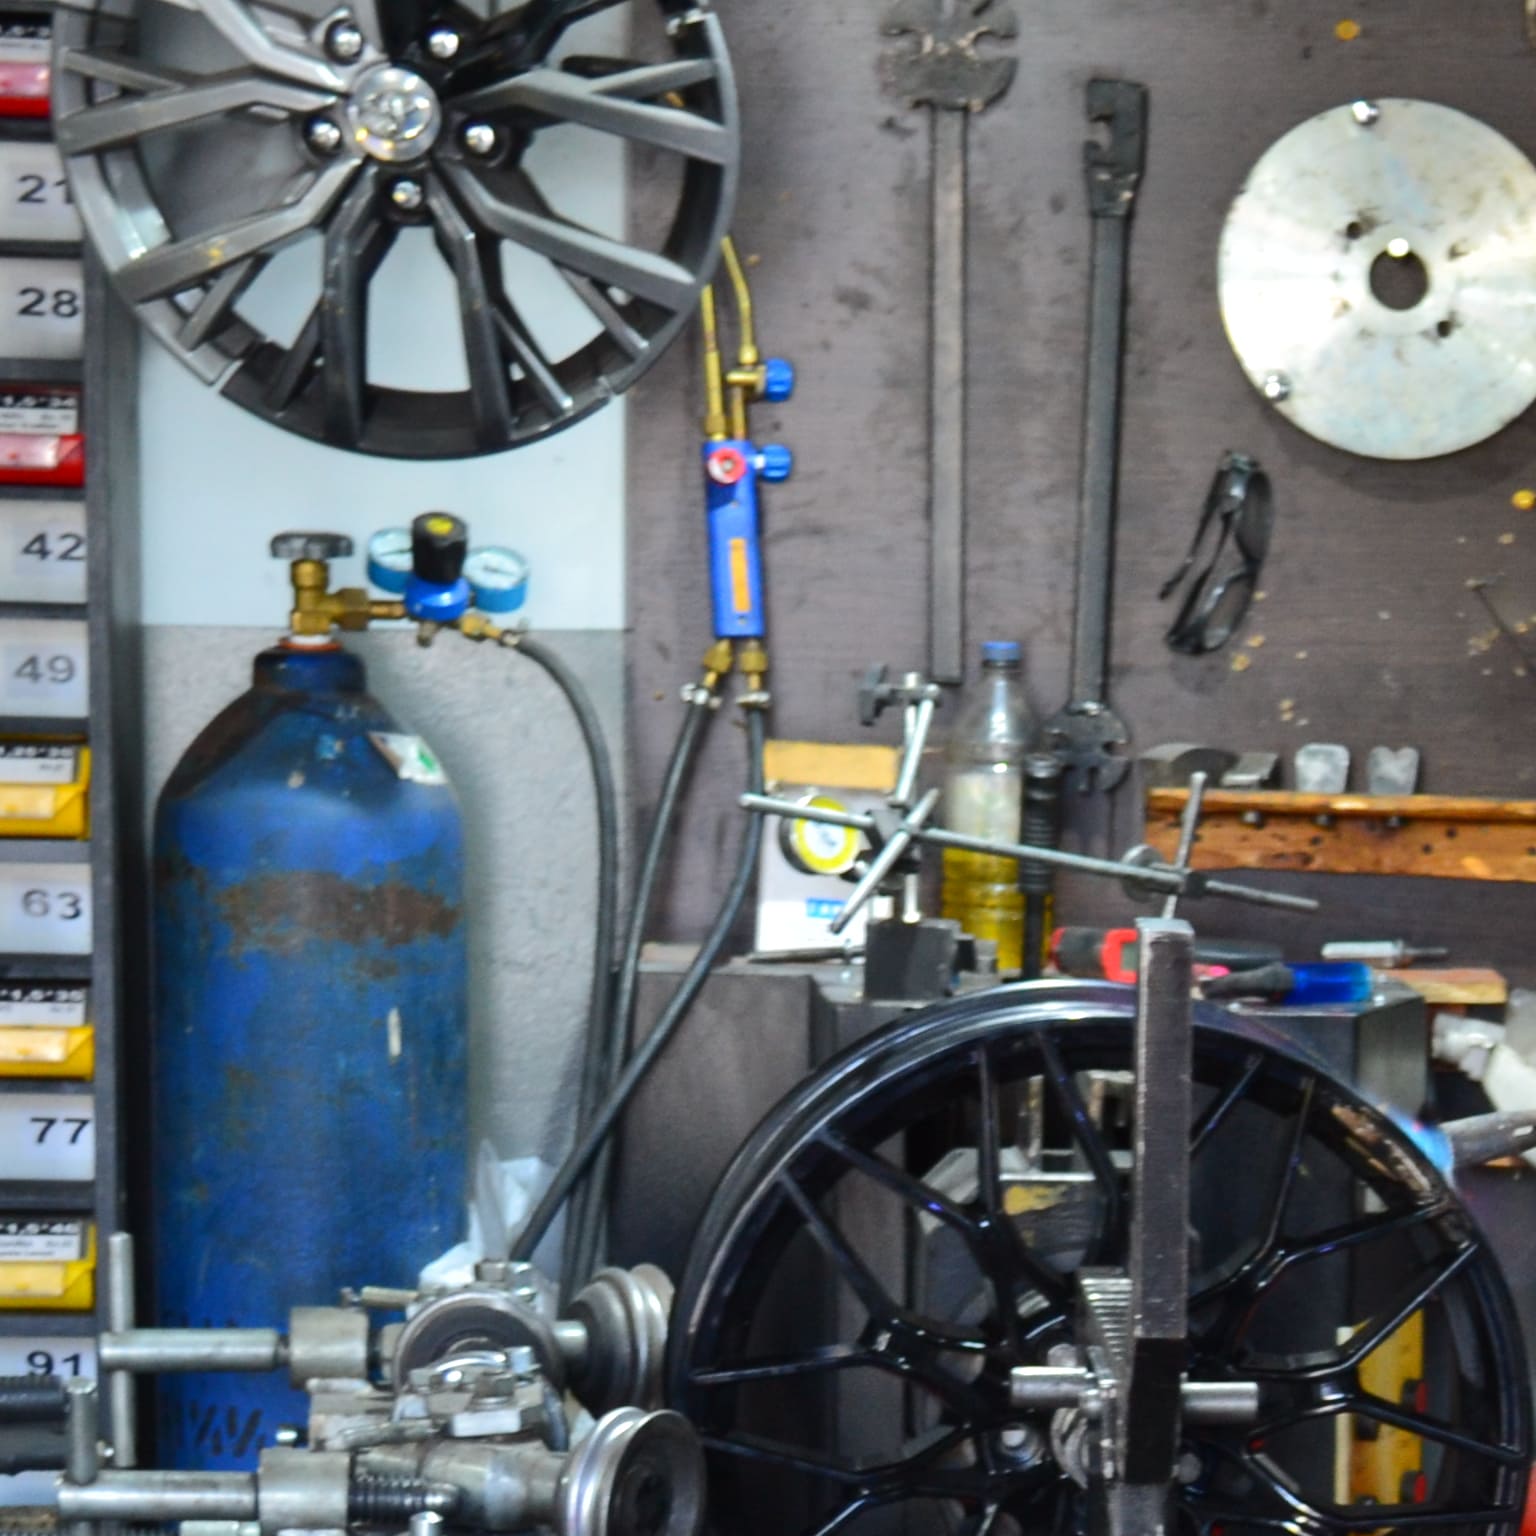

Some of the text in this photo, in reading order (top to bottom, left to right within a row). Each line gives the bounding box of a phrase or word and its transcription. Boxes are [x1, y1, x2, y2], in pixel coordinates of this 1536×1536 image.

[17, 175, 74, 205] 21
[17, 287, 80, 319] 28
[20, 532, 87, 561] 42
[13, 655, 76, 685] 49
[22, 888, 82, 920] 63
[30, 1117, 91, 1144] 77
[26, 1351, 80, 1377] 91
